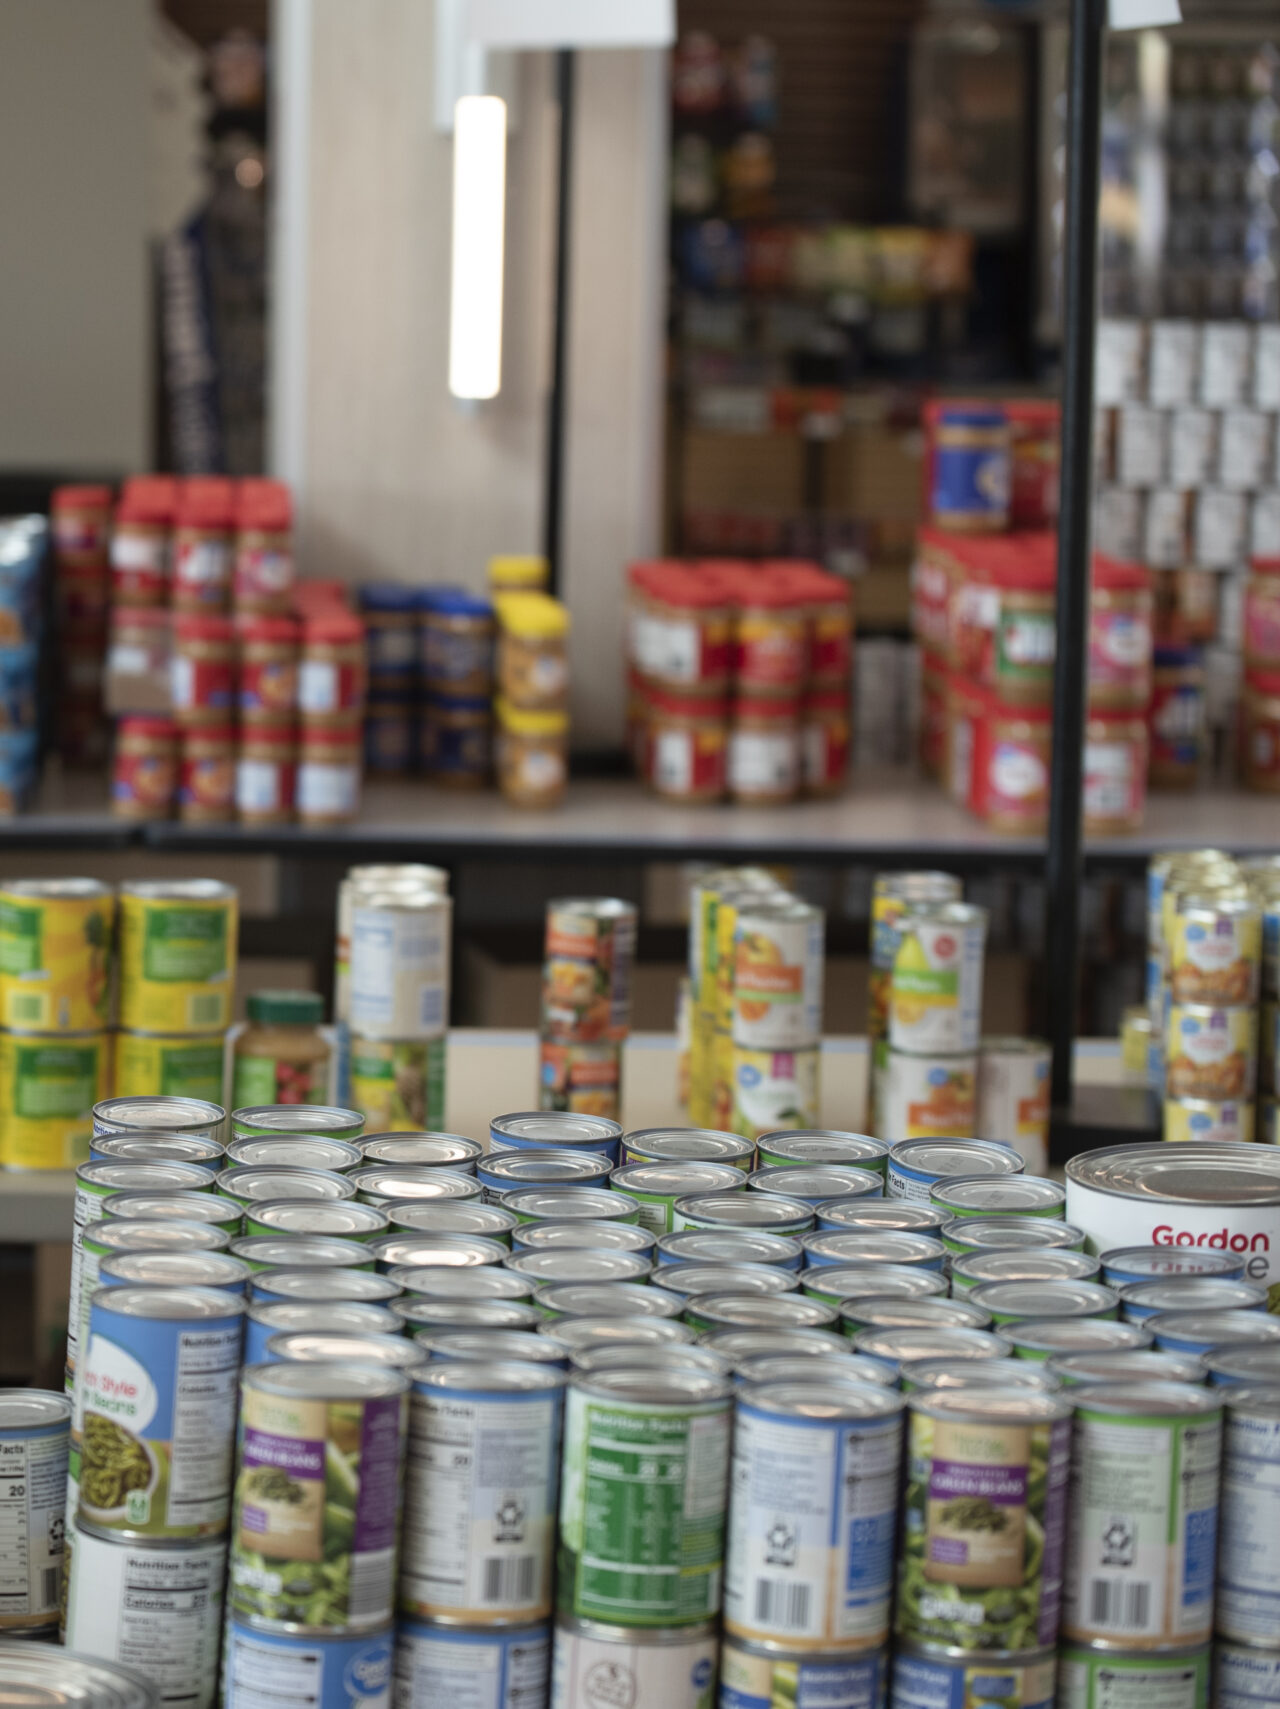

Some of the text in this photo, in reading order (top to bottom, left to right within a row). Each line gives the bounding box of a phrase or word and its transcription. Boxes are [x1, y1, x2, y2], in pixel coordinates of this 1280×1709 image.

[892, 1175, 905, 1190] Facts
[1152, 1225, 1269, 1253] Gordon
[102, 1375, 137, 1397] Style
[9, 1485, 25, 1497] 20
